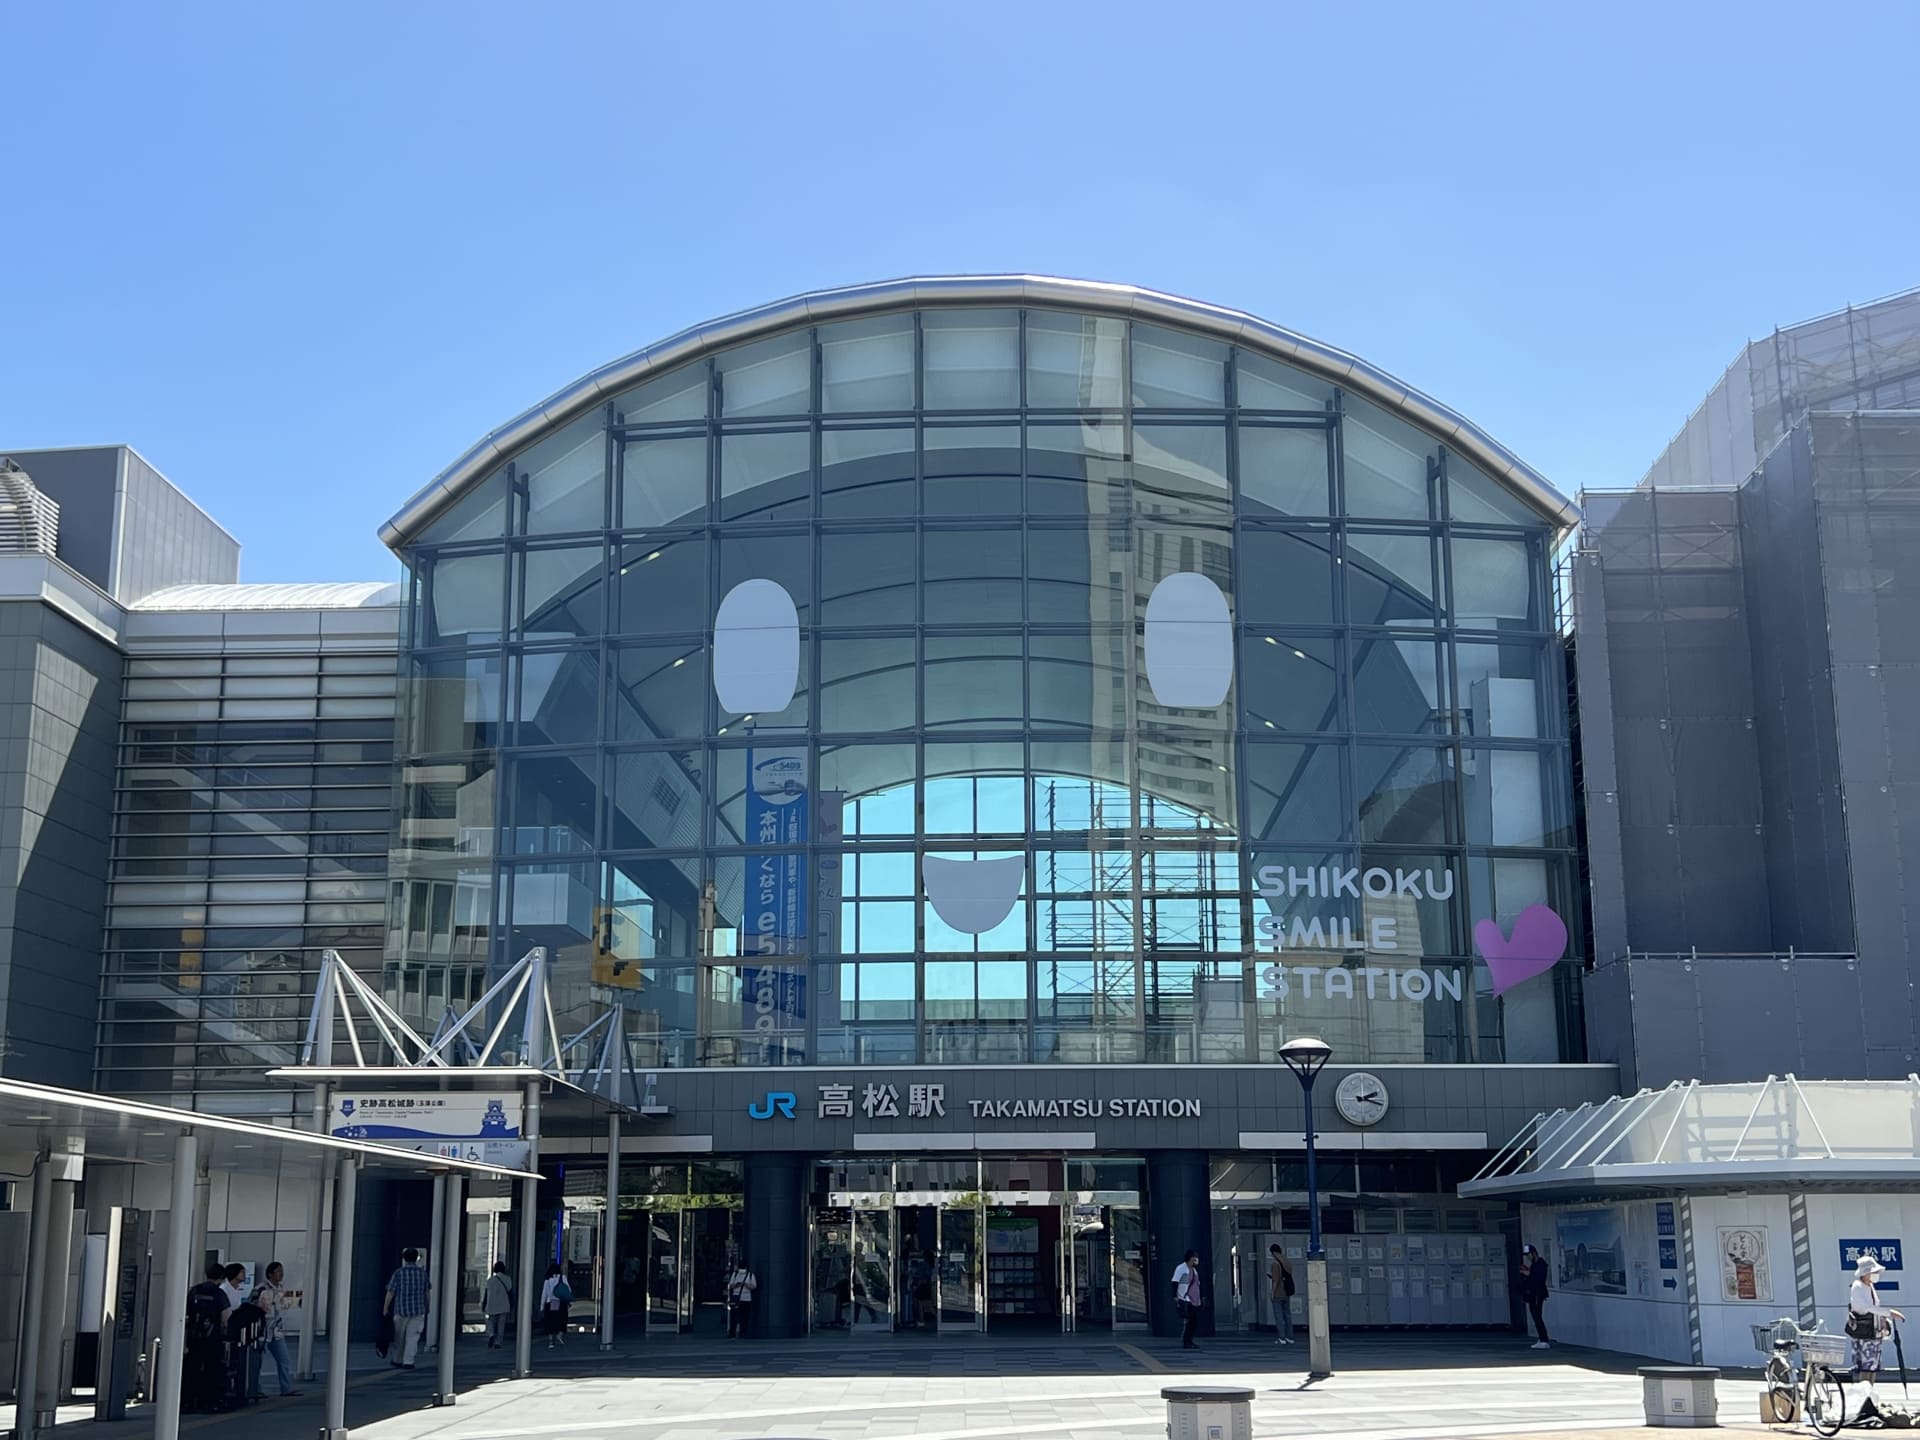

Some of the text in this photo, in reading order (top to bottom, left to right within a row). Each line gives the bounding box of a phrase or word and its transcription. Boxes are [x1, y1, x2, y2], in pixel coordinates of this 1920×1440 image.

[759, 809, 777, 905] 本州くなら
[1258, 865, 1454, 901] SHIKOKU
[1259, 915, 1399, 950] SMILE
[1262, 966, 1462, 1002] STATION
[748, 1092, 798, 1119] JR
[817, 1083, 947, 1119] 高松駅
[968, 1098, 1202, 1118] TAKAMATSU STATION
[1845, 1246, 1897, 1262] 高松駅
